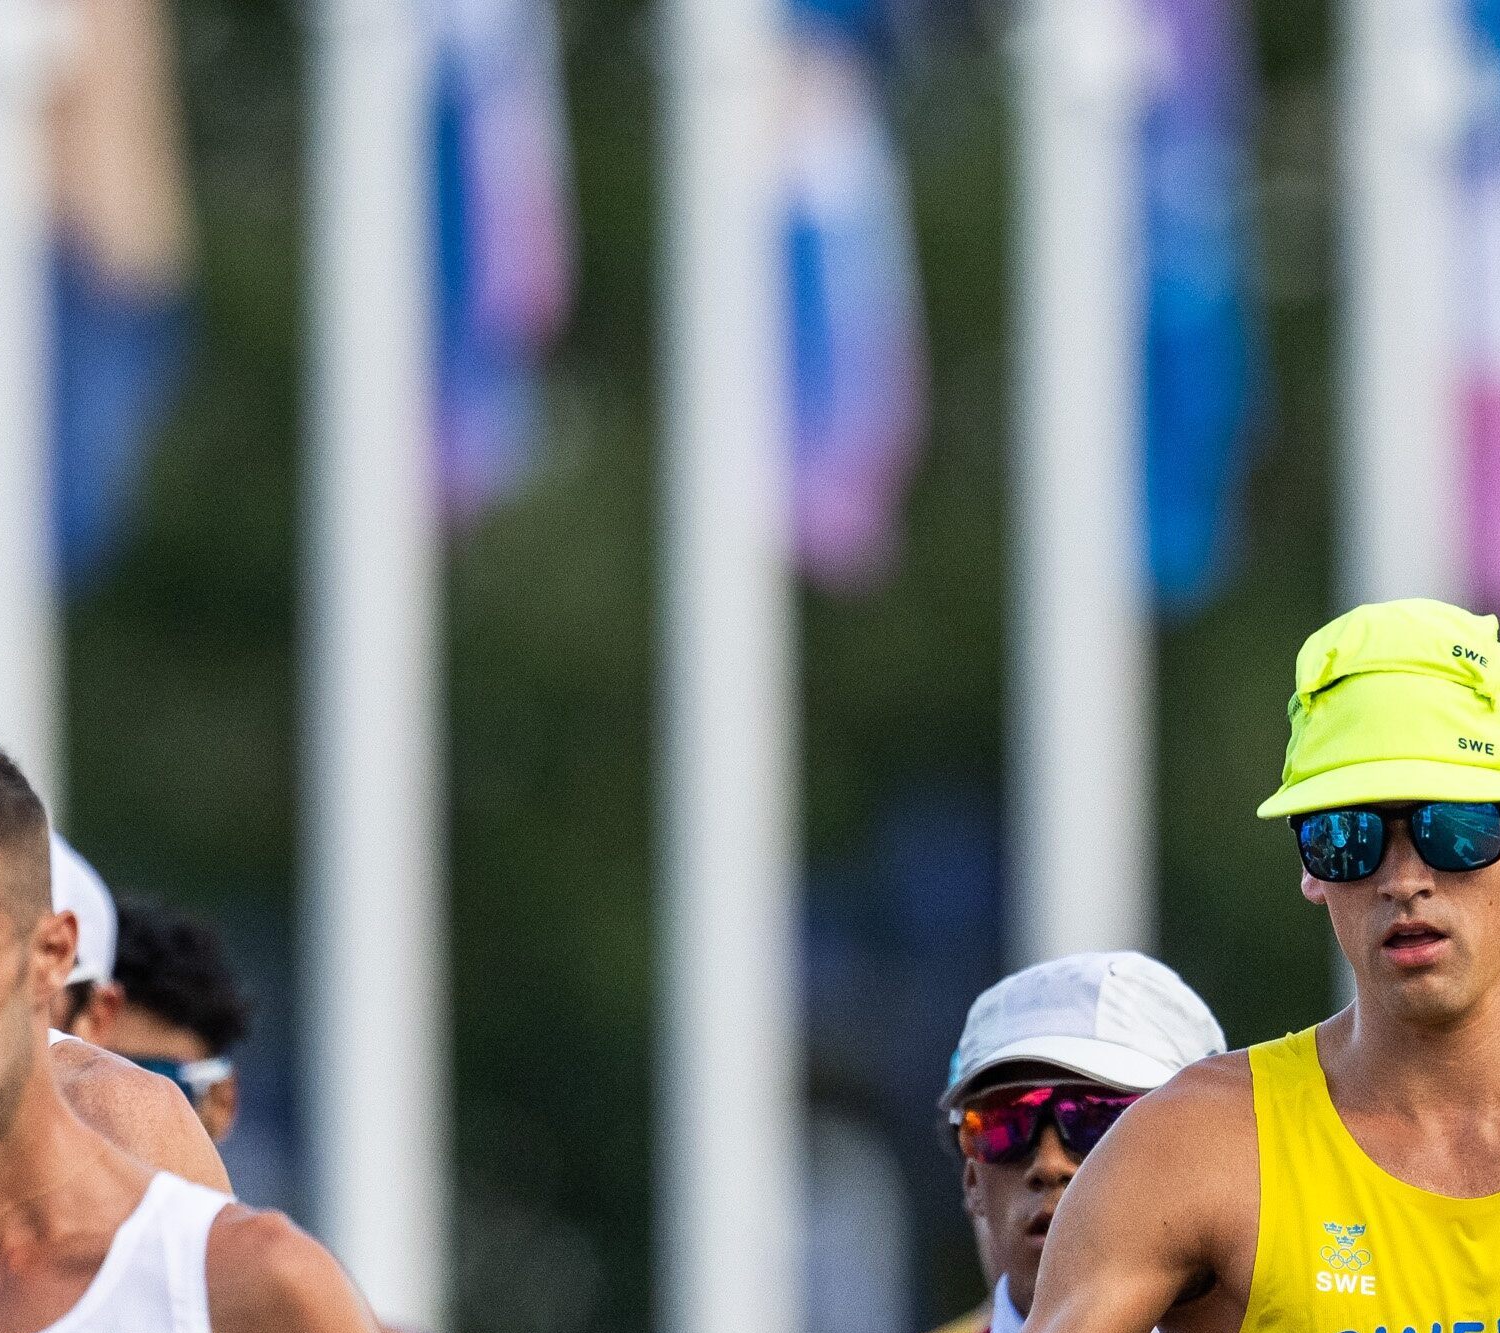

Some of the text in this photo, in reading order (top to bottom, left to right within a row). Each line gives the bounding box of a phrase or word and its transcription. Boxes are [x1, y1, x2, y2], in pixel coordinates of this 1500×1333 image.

[1452, 645, 1488, 668] SWE
[1458, 737, 1495, 756] SWE
[1315, 1269, 1378, 1297] SWE
